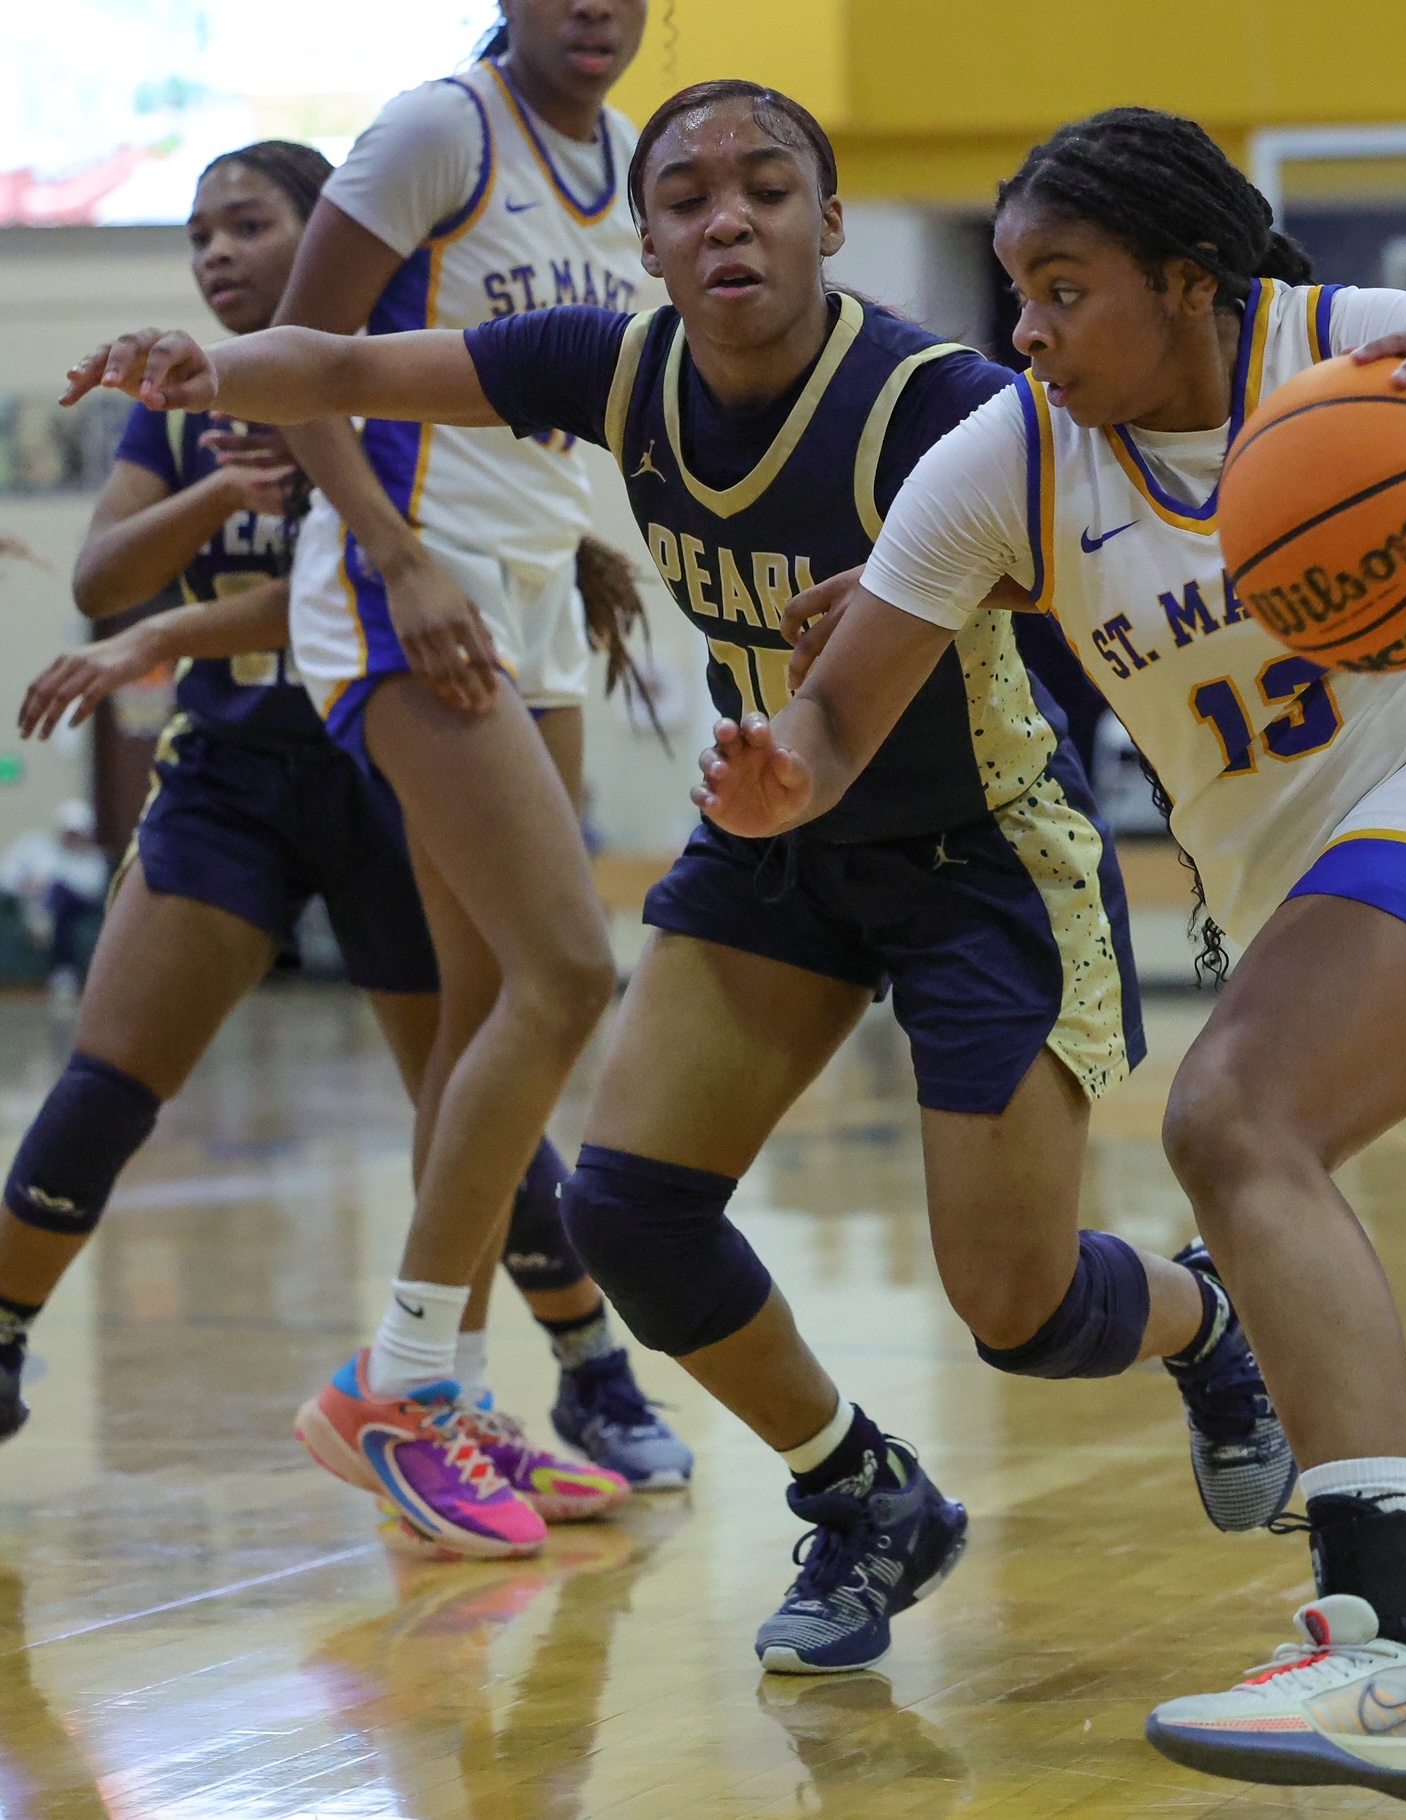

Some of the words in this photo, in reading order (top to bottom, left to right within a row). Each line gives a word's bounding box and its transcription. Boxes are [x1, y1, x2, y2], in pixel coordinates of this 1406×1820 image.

[483, 264, 547, 318] ST.
[1091, 612, 1161, 680] ST.
[1156, 567, 1252, 649] MA
[1187, 651, 1344, 778] 13
